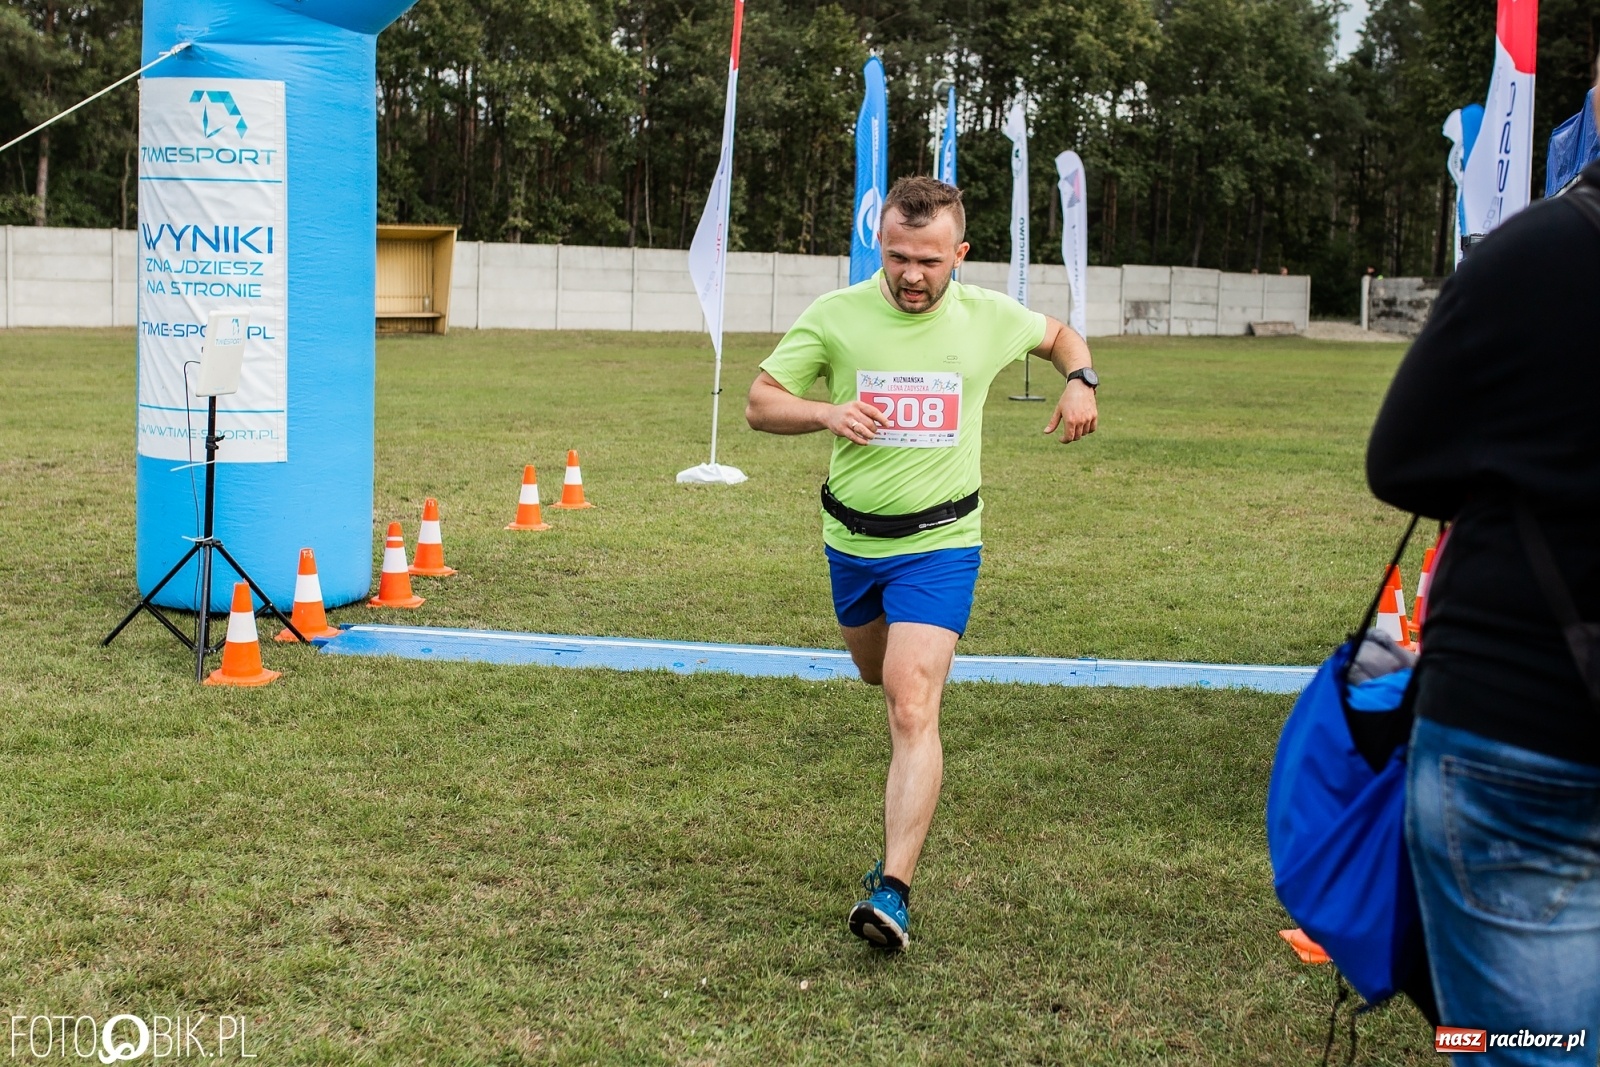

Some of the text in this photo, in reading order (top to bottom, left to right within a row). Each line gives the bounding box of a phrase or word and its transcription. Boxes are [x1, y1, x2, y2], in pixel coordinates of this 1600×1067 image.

[141, 147, 277, 165] TIMESPORT
[142, 223, 273, 254] WYNIKI
[146, 258, 264, 276] ZNAJDZIESZ
[146, 280, 261, 298] NA STRONIE
[873, 396, 945, 428] 208
